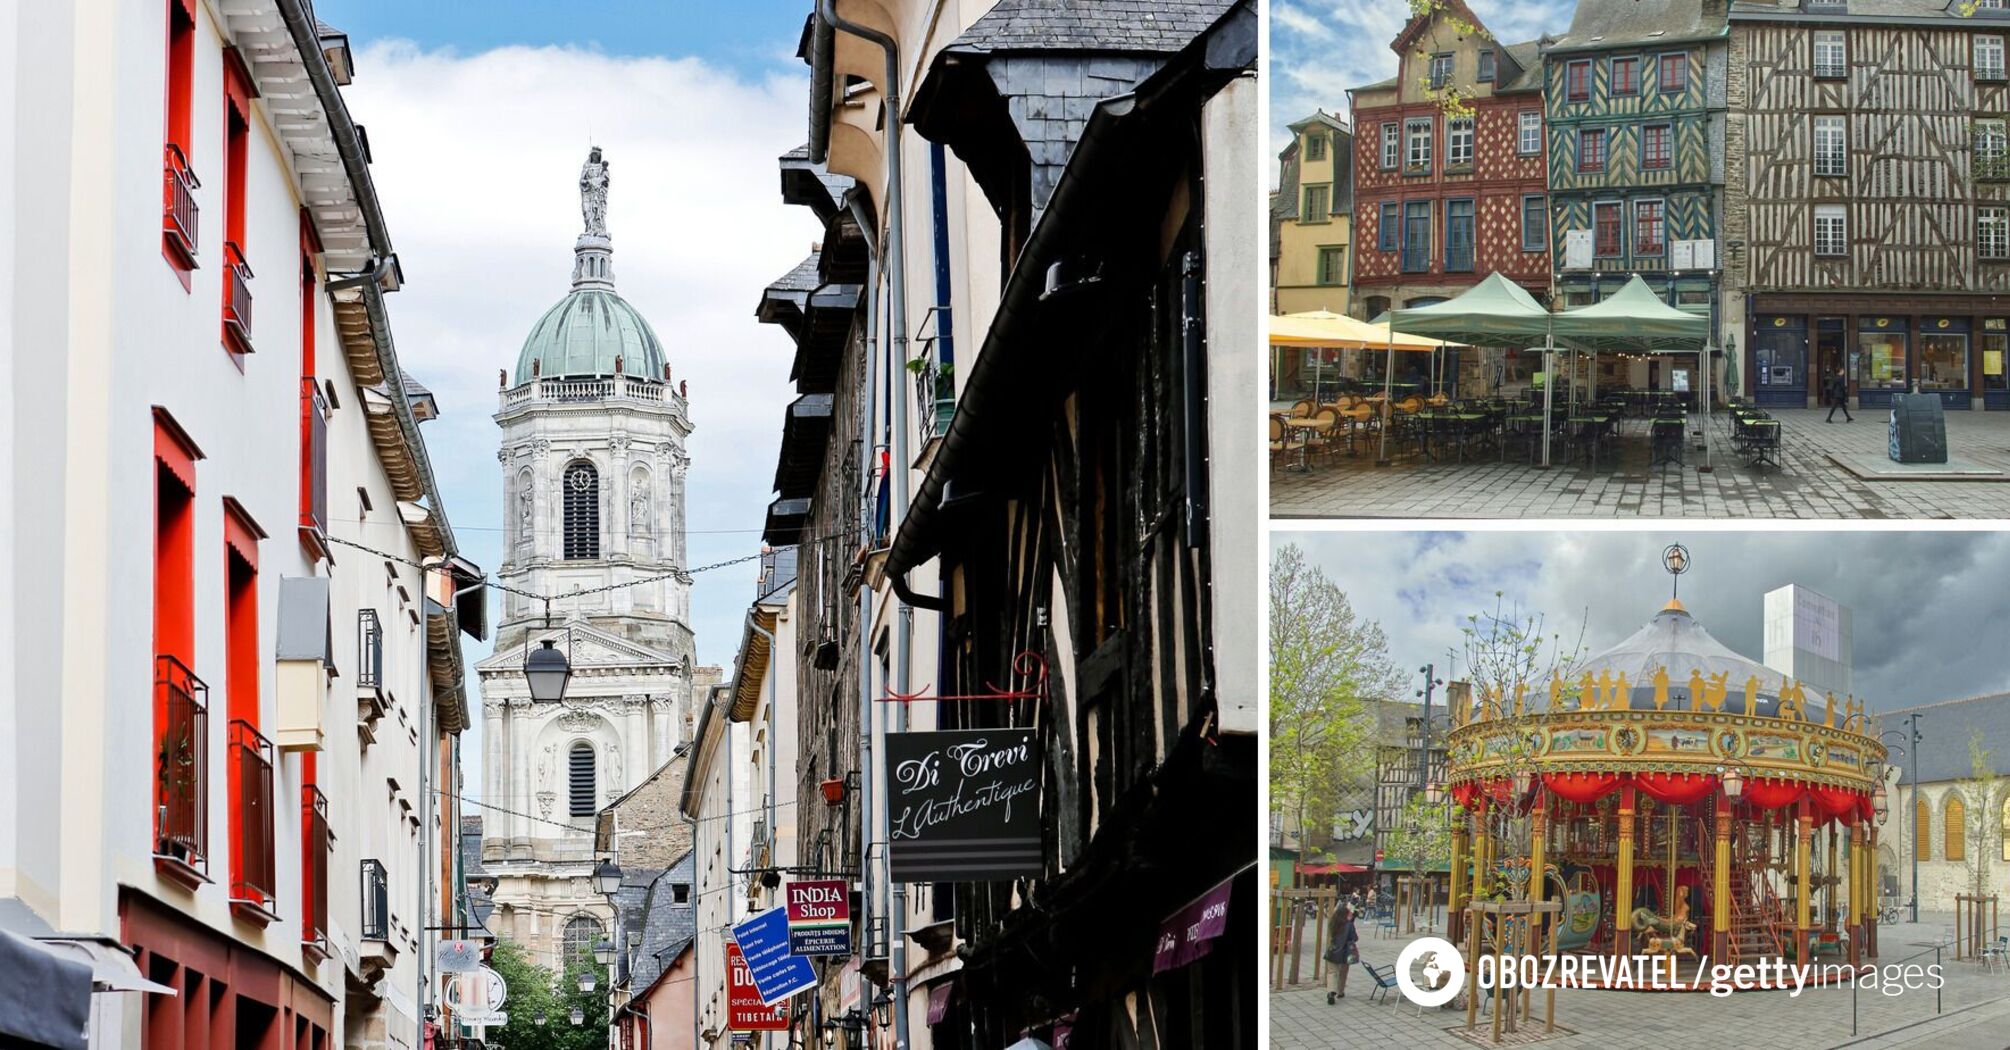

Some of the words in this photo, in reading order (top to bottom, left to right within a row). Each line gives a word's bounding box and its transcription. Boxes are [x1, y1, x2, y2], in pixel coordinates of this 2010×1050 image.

[896, 751, 940, 795] Di
[947, 736, 1028, 777] Trevi
[792, 886, 843, 904] INDIA
[800, 903, 836, 919] Shop
[794, 943, 846, 952] ALIMENTATION
